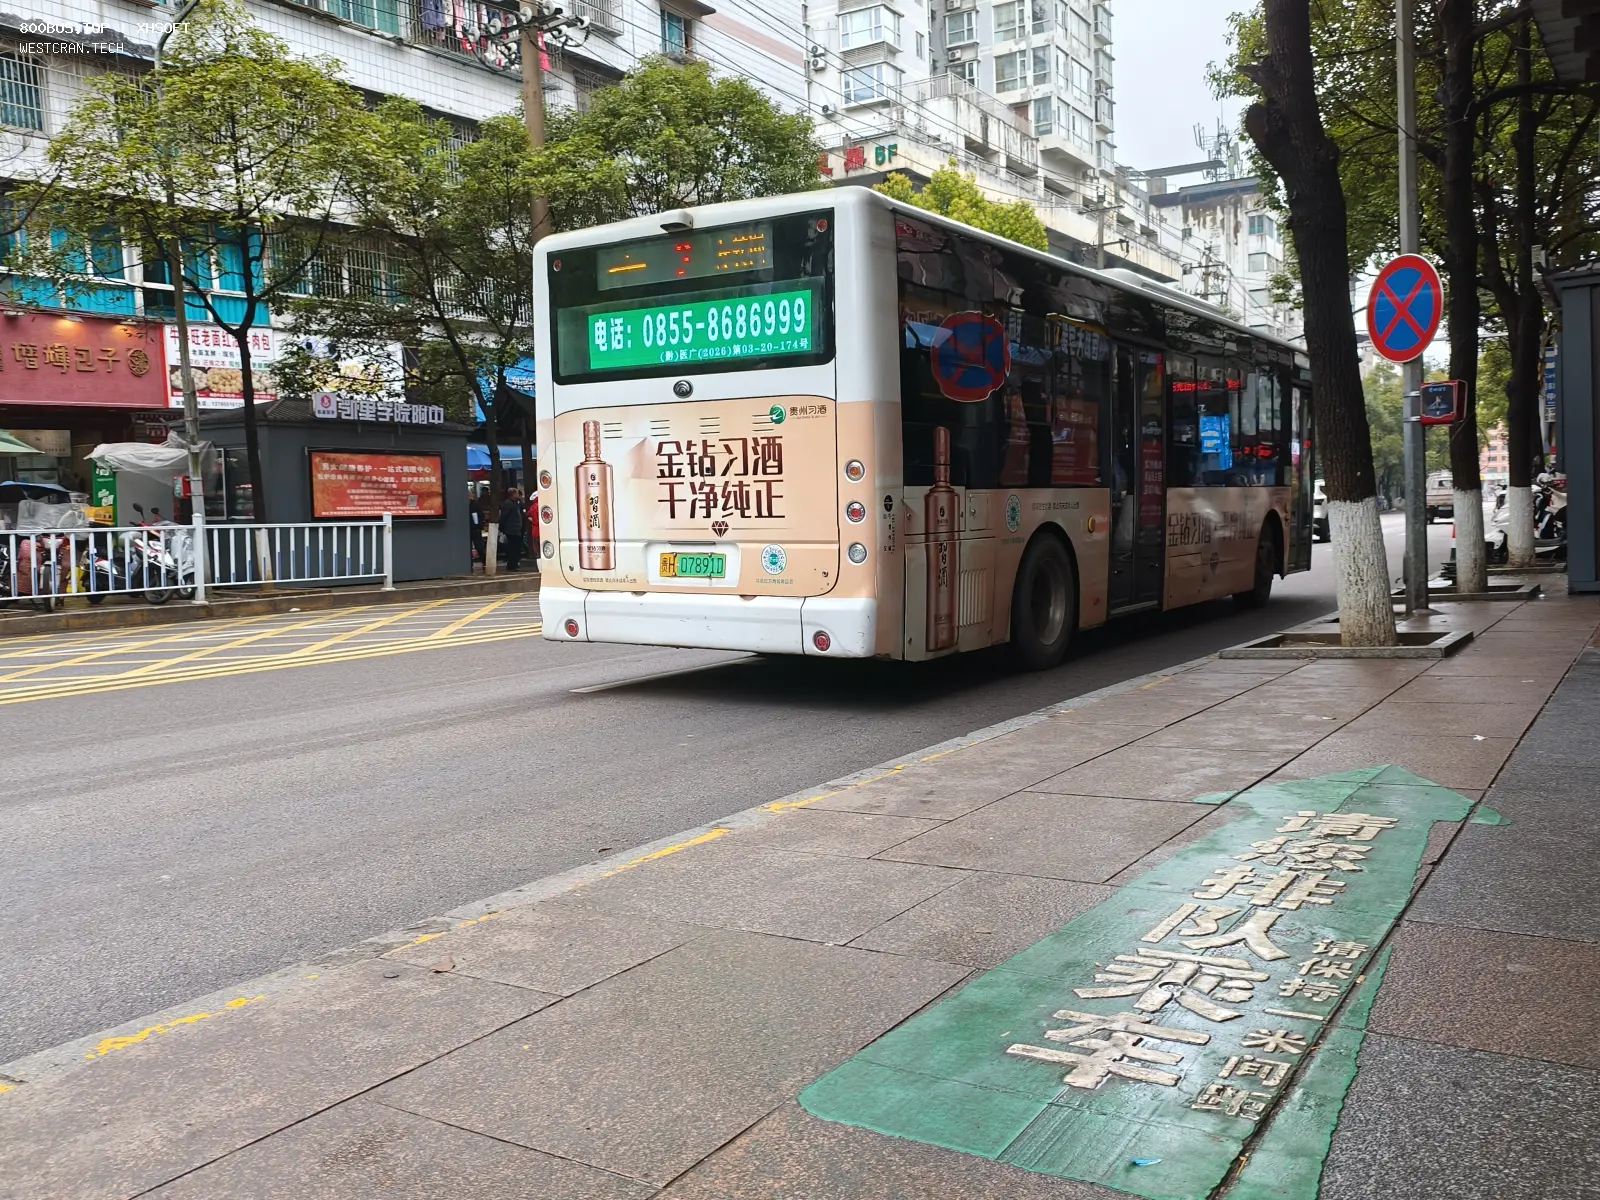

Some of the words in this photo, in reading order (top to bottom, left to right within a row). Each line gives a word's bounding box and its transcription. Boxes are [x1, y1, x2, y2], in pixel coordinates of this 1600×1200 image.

[339, 399, 444, 424] 凯里学院附中
[789, 404, 827, 417] 贵州习酒
[655, 435, 783, 478] 金钻习酒
[657, 479, 786, 519] 干净纯正
[680, 556, 724, 574] 07891D
[1006, 810, 1399, 1090] 请您排队乘车
